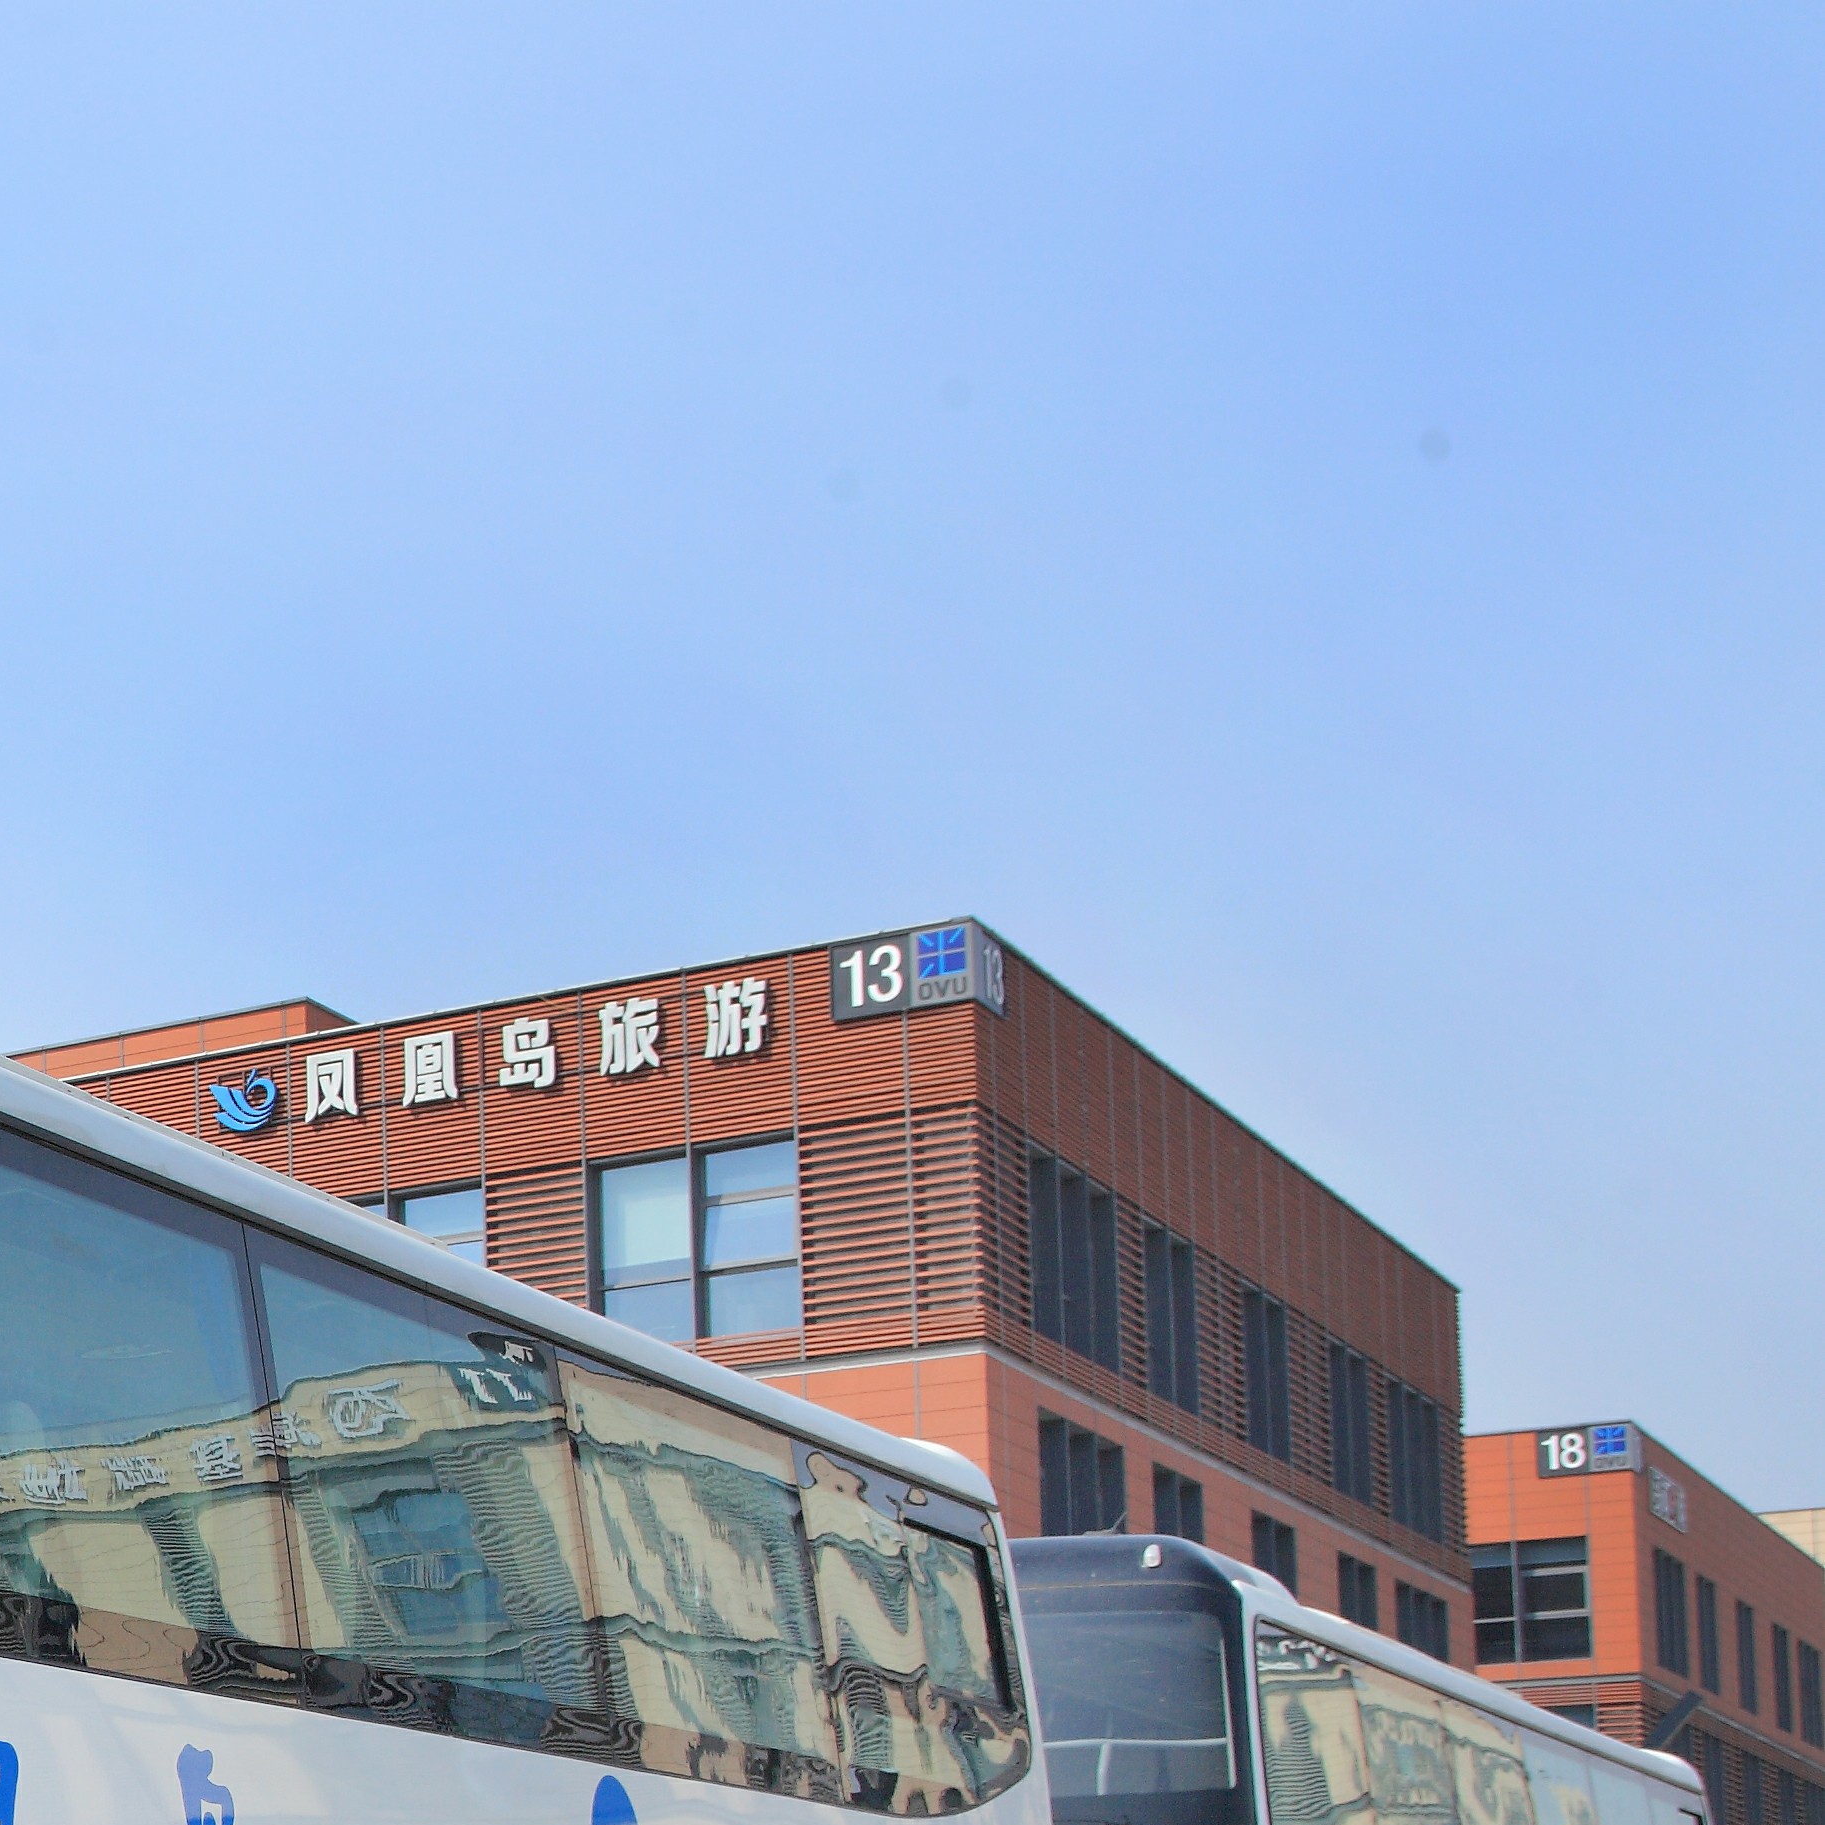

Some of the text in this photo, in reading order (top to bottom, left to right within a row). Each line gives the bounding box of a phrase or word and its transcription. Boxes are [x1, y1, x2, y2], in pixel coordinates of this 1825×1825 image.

[839, 943, 904, 1009] 13
[917, 975, 968, 1002] OVU
[304, 976, 771, 1124] 凤凰岛旅游
[1540, 1432, 1586, 1471] 18
